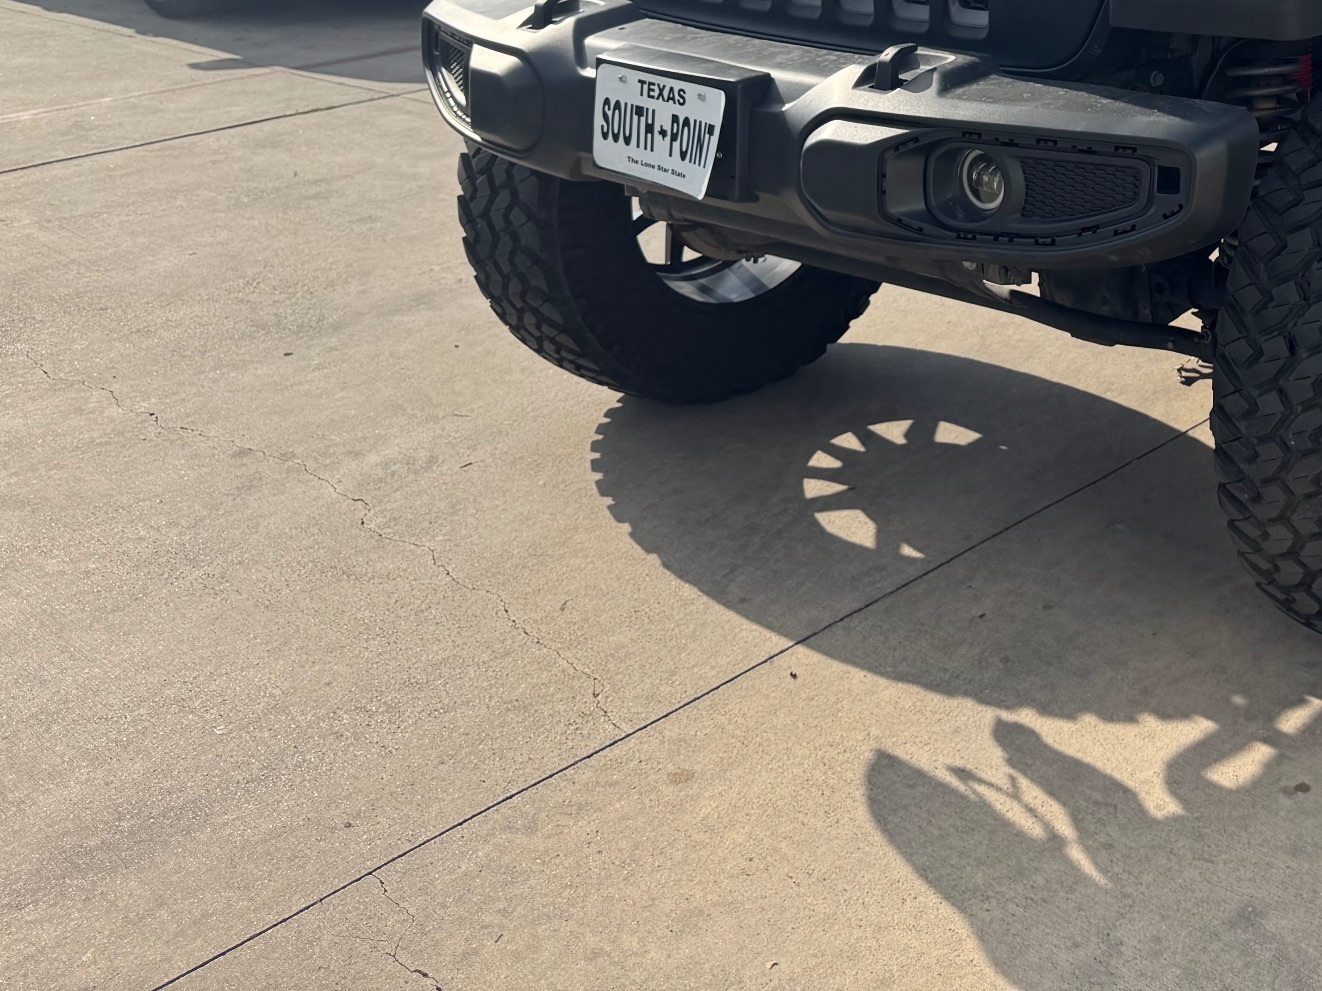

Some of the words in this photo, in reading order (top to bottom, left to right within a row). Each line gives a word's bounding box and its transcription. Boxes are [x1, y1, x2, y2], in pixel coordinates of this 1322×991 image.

[638, 79, 687, 107] TEXAS
[601, 97, 656, 153] SOUTH
[669, 113, 716, 169] POINT
[627, 156, 639, 165] The
[641, 159, 655, 170] Lone
[657, 165, 669, 173] Star
[671, 168, 686, 179] State
